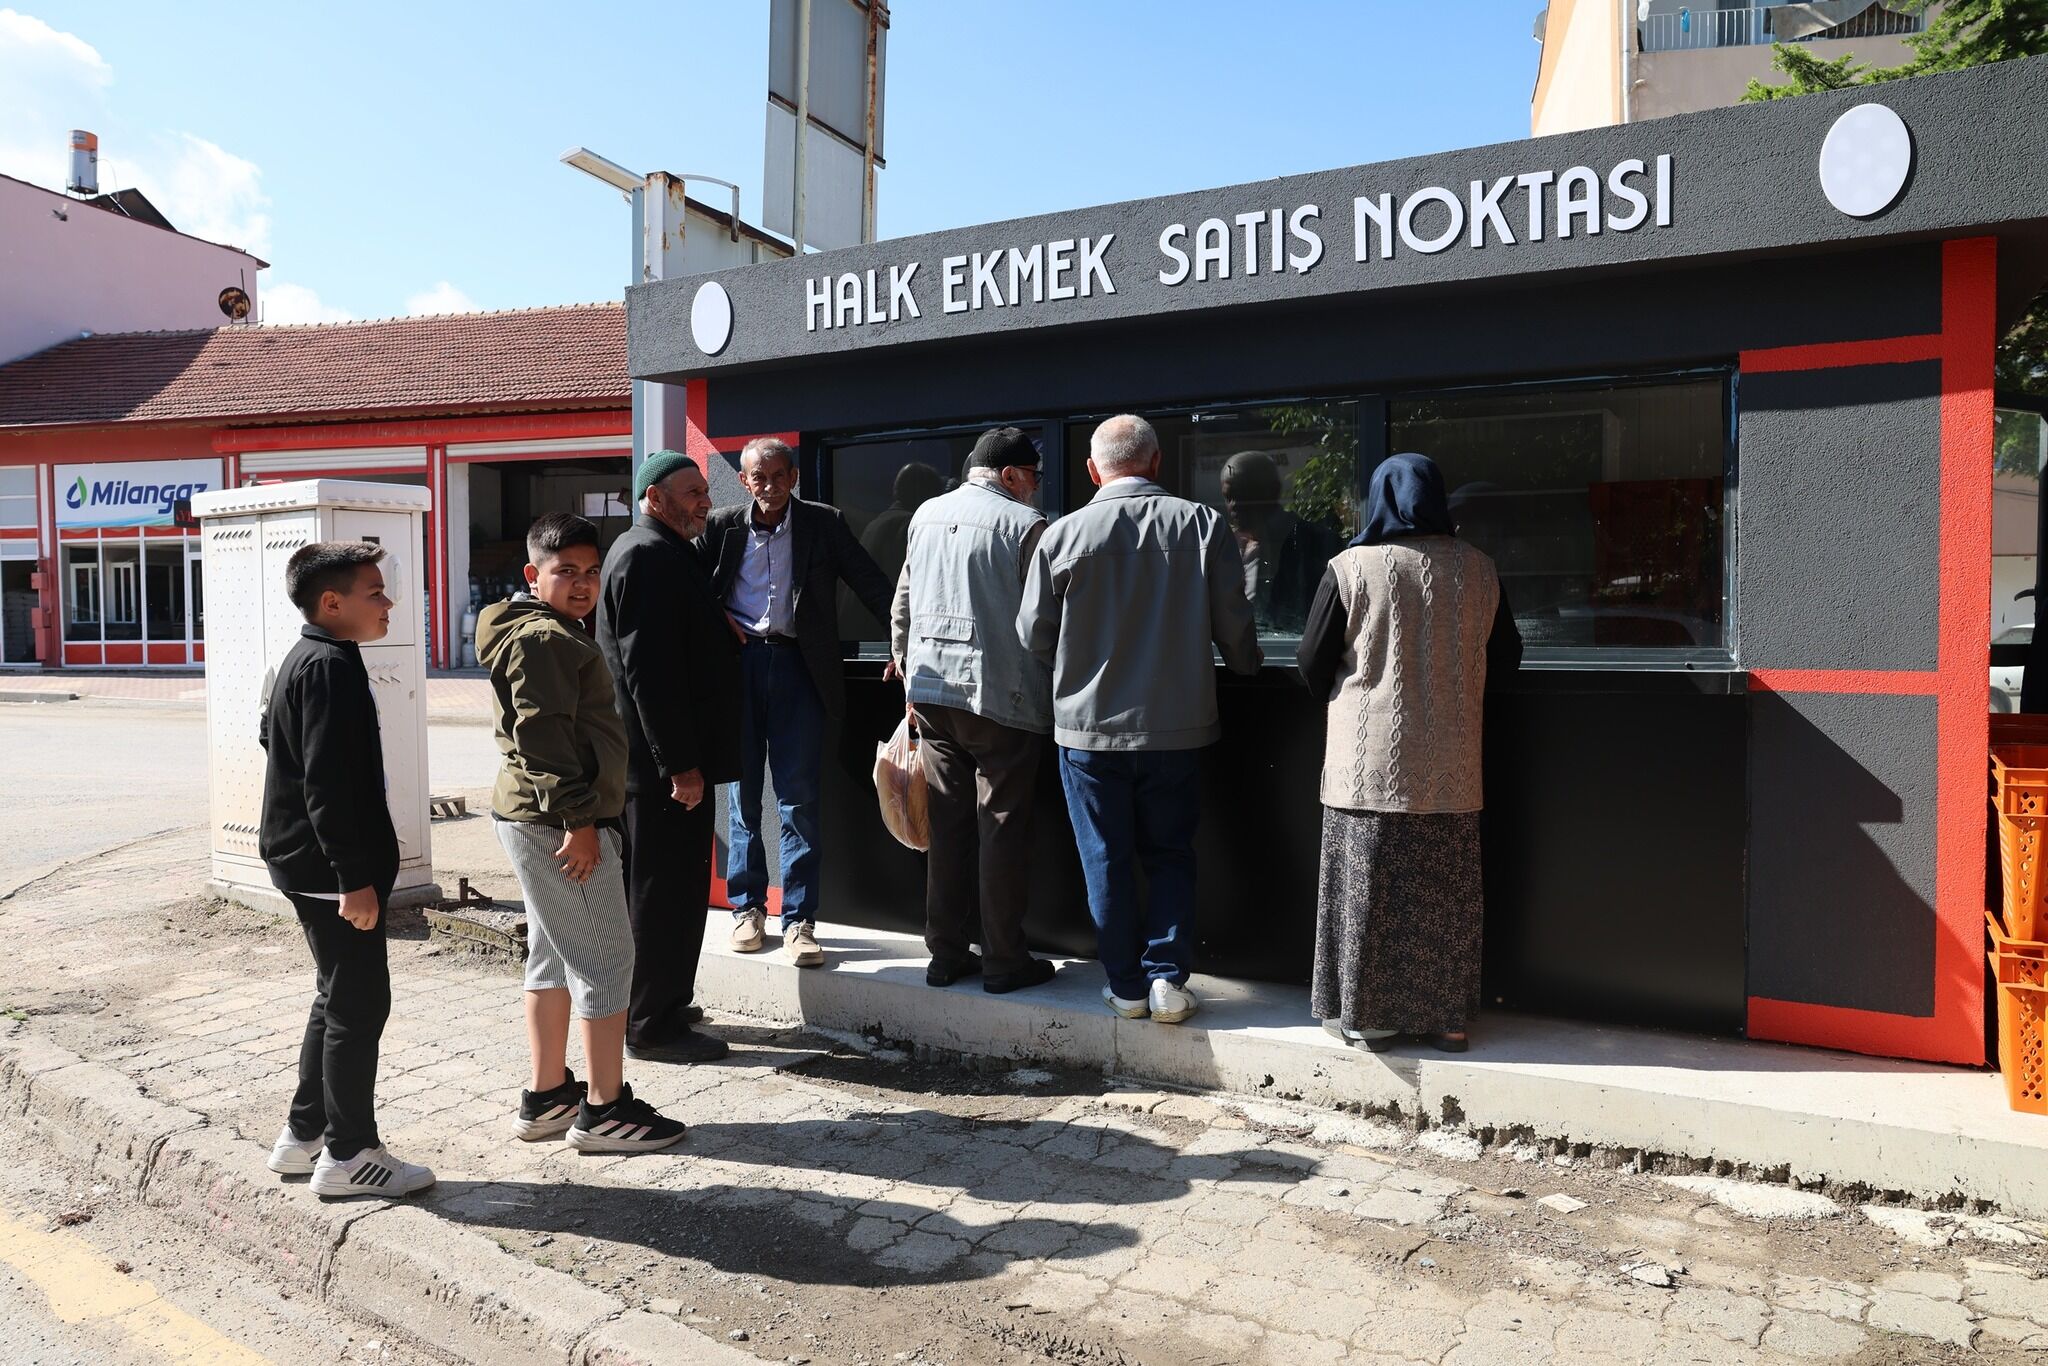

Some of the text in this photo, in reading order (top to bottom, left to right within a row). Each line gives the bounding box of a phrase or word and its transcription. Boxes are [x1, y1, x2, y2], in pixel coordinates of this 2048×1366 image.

[805, 153, 1671, 331] HALK EKMEK SATIŞ NOKTASI
